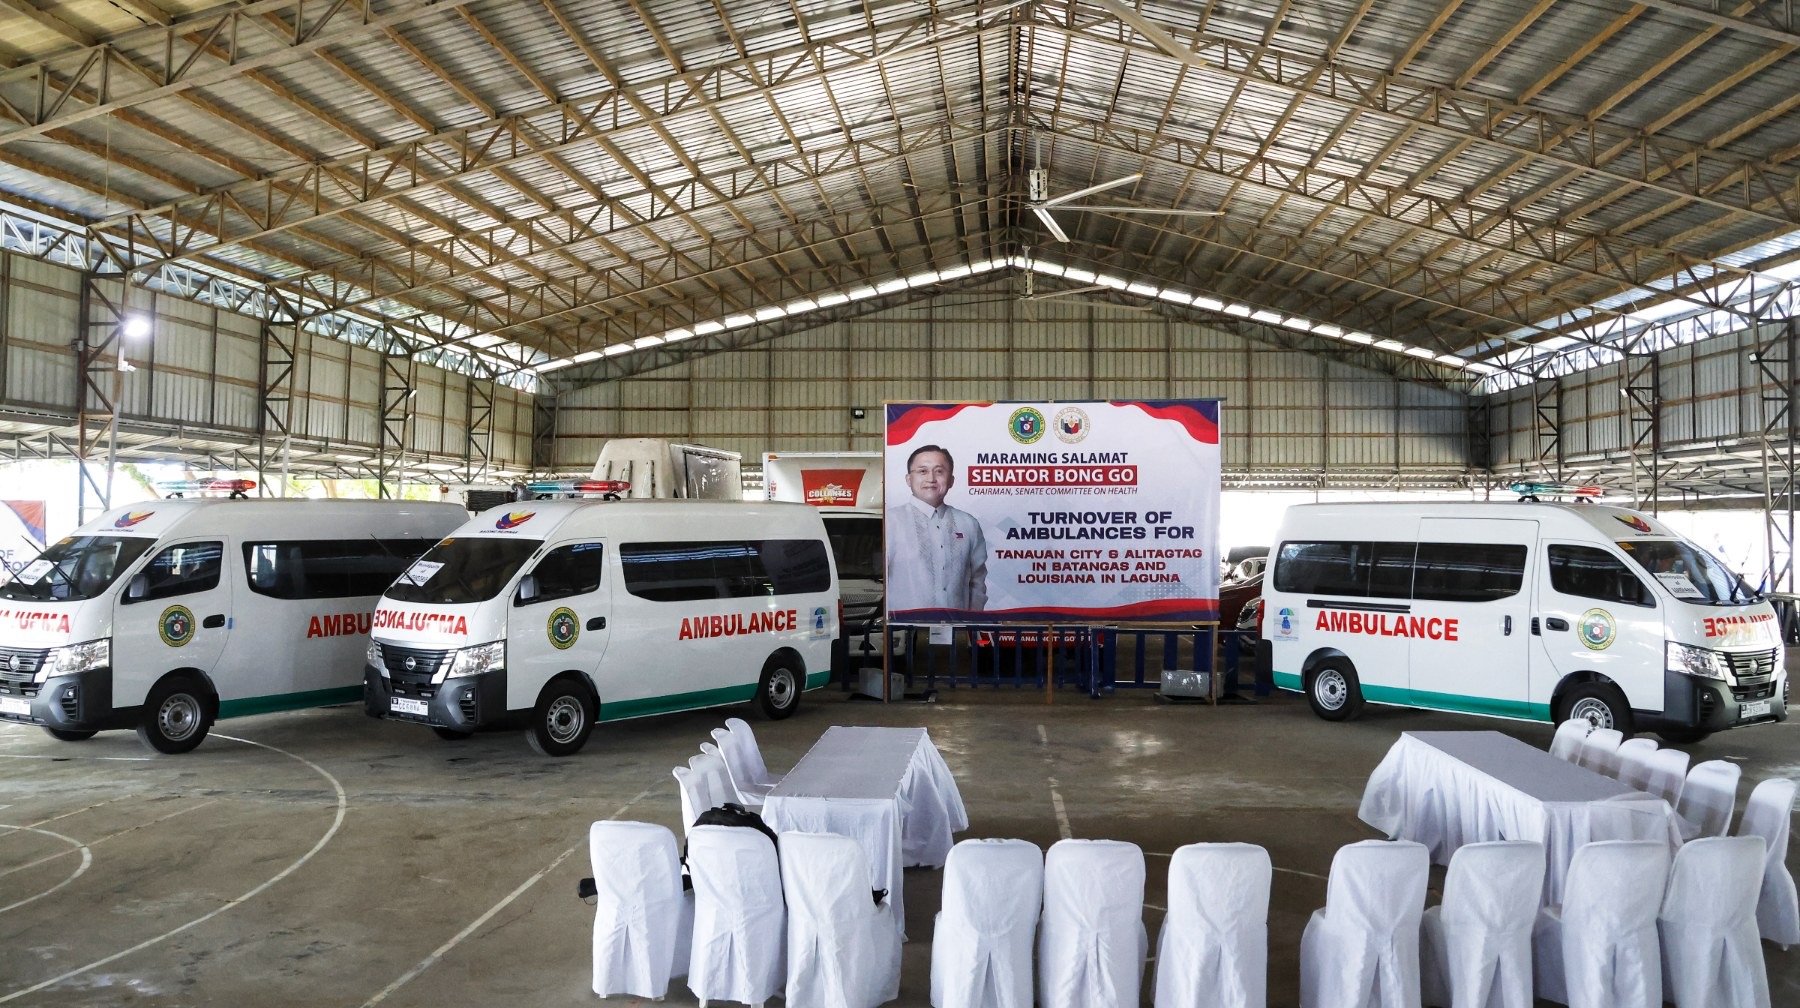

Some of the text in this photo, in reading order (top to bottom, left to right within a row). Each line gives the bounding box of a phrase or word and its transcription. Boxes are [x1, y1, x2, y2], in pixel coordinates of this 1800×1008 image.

[976, 452, 1129, 464] MARAMING SALAMAT
[971, 468, 1134, 483] SENATOR BONG GO
[968, 486, 1138, 496] CHAIRMAN, SENATE COMMITTEE ON HEALTH
[1027, 511, 1173, 525] TURNOVER OF
[1005, 526, 1195, 540] AMBULANCES FOR
[994, 549, 1065, 560] TANAUAN
[1069, 549, 1104, 559] CITY
[1124, 548, 1203, 559] ALITAGTAG
[1031, 561, 1167, 572] IN BATANGAS AND
[1017, 573, 1181, 584] LOUISIANA IN LAGUNA
[679, 609, 797, 640] AMBULANCE
[1315, 610, 1459, 642] AMBULANCE
